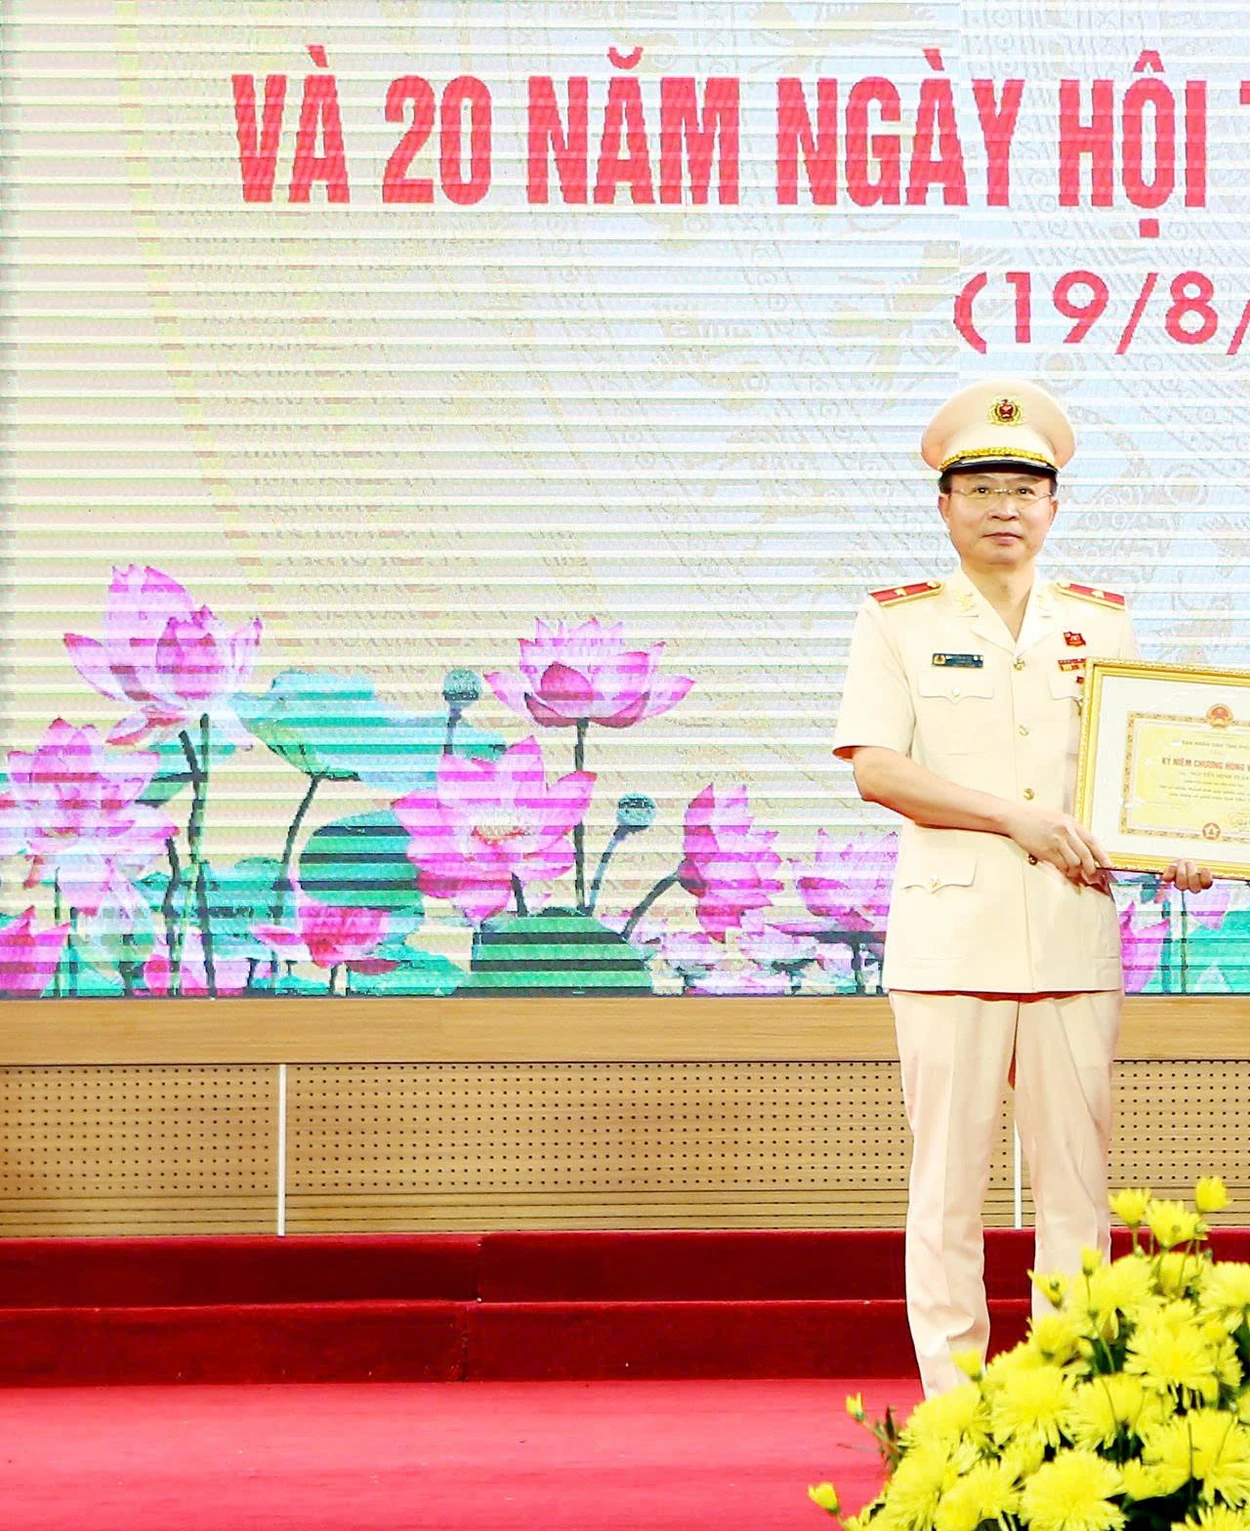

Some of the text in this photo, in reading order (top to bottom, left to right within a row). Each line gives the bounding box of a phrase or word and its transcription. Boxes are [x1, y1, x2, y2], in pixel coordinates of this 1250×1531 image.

[230, 45, 350, 204] VÀ
[383, 75, 491, 205] 20
[527, 47, 739, 204] NĂM
[777, 49, 1024, 206] NGÀY
[1060, 51, 1206, 237] HỘI
